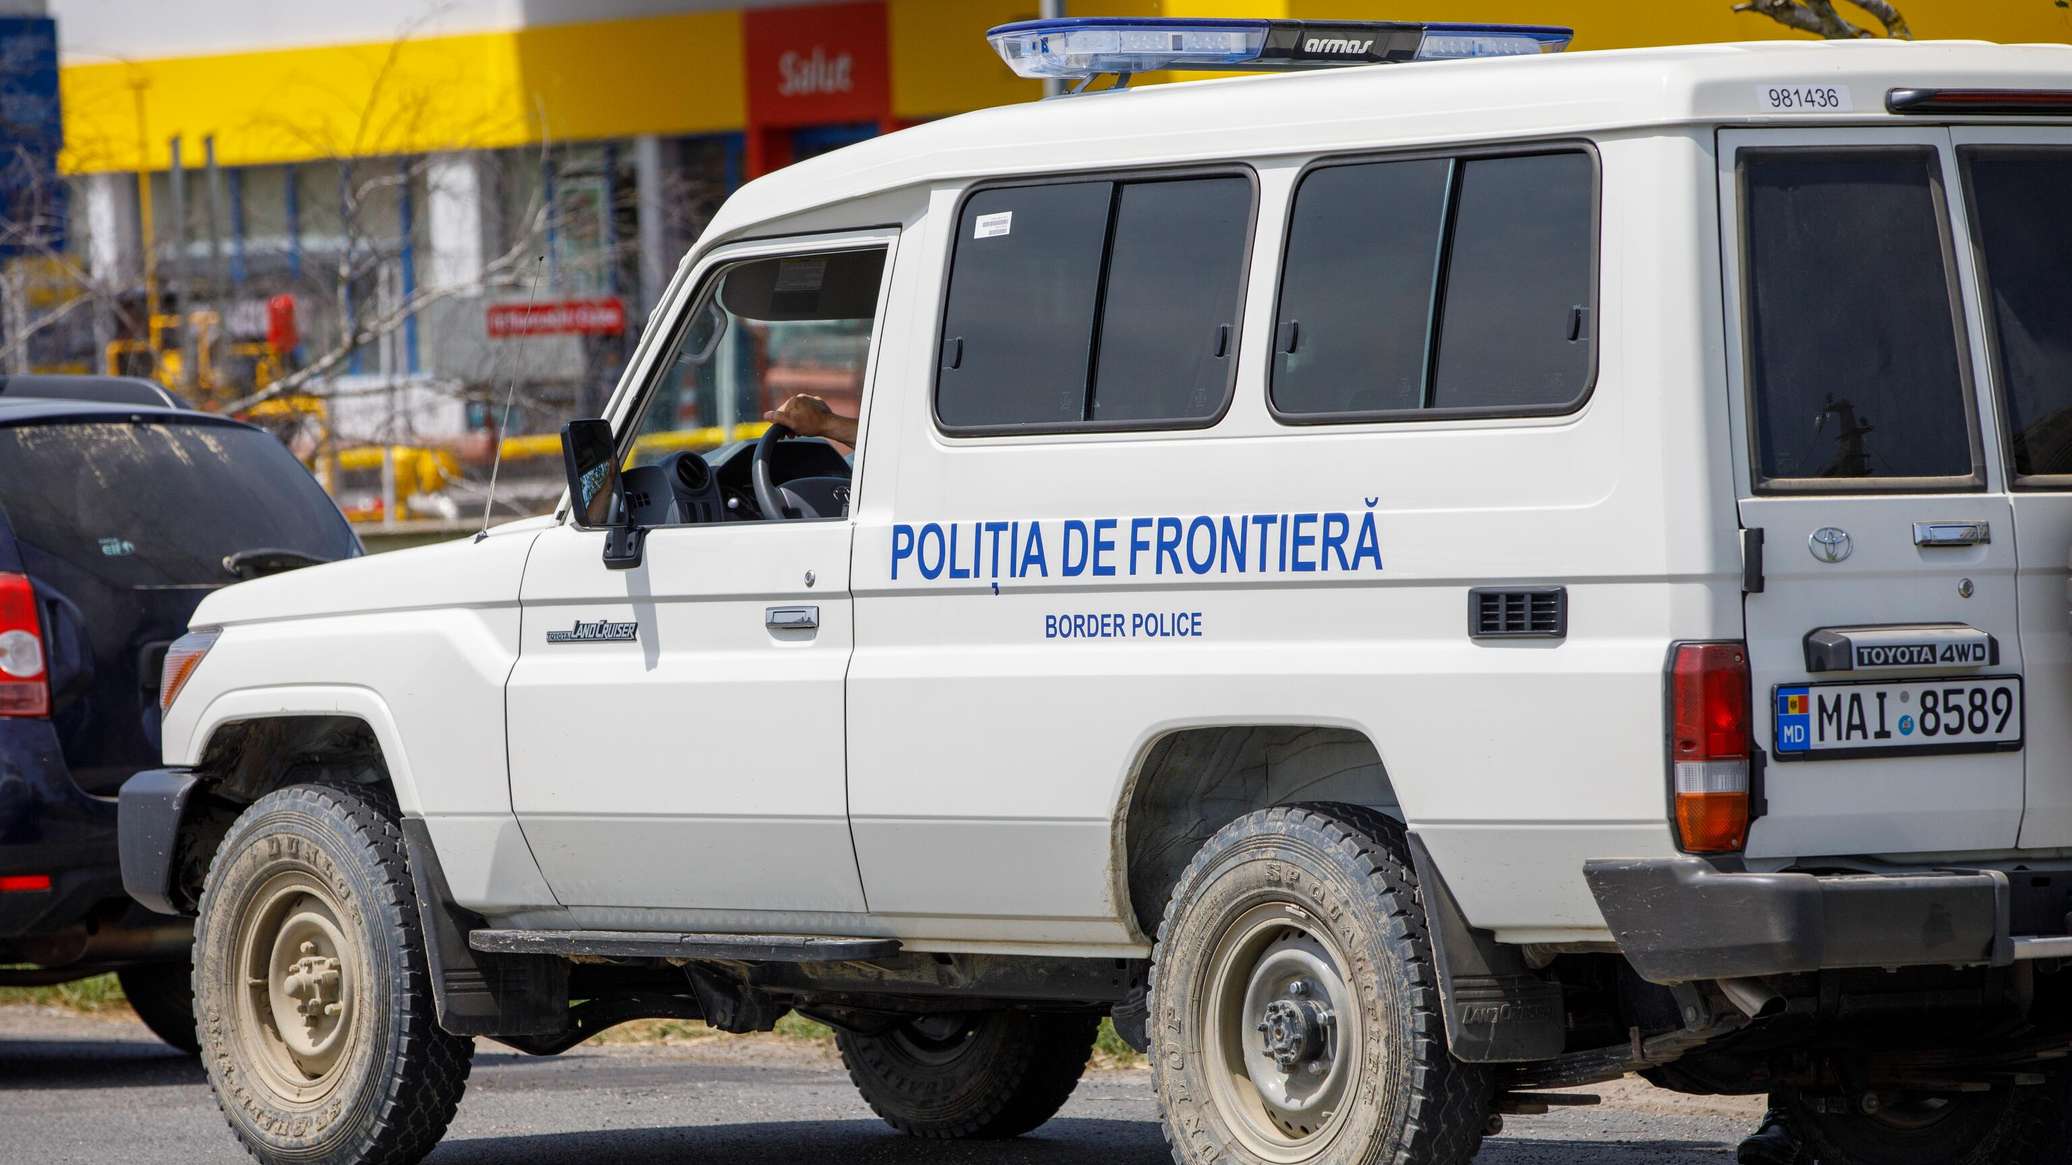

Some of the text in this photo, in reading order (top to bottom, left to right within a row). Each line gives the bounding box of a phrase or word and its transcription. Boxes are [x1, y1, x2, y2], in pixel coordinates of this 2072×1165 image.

[1304, 38, 1373, 54] armas
[1768, 88, 1839, 108] 981436
[1062, 518, 1118, 578] DE
[1129, 496, 1384, 577] FRONTIERĂ
[1045, 612, 1203, 639] BORDER POLICE
[1859, 643, 1986, 665] TOYOTA 4WD
[1817, 686, 2013, 742] MAI 8589
[1783, 725, 1805, 743] MD
